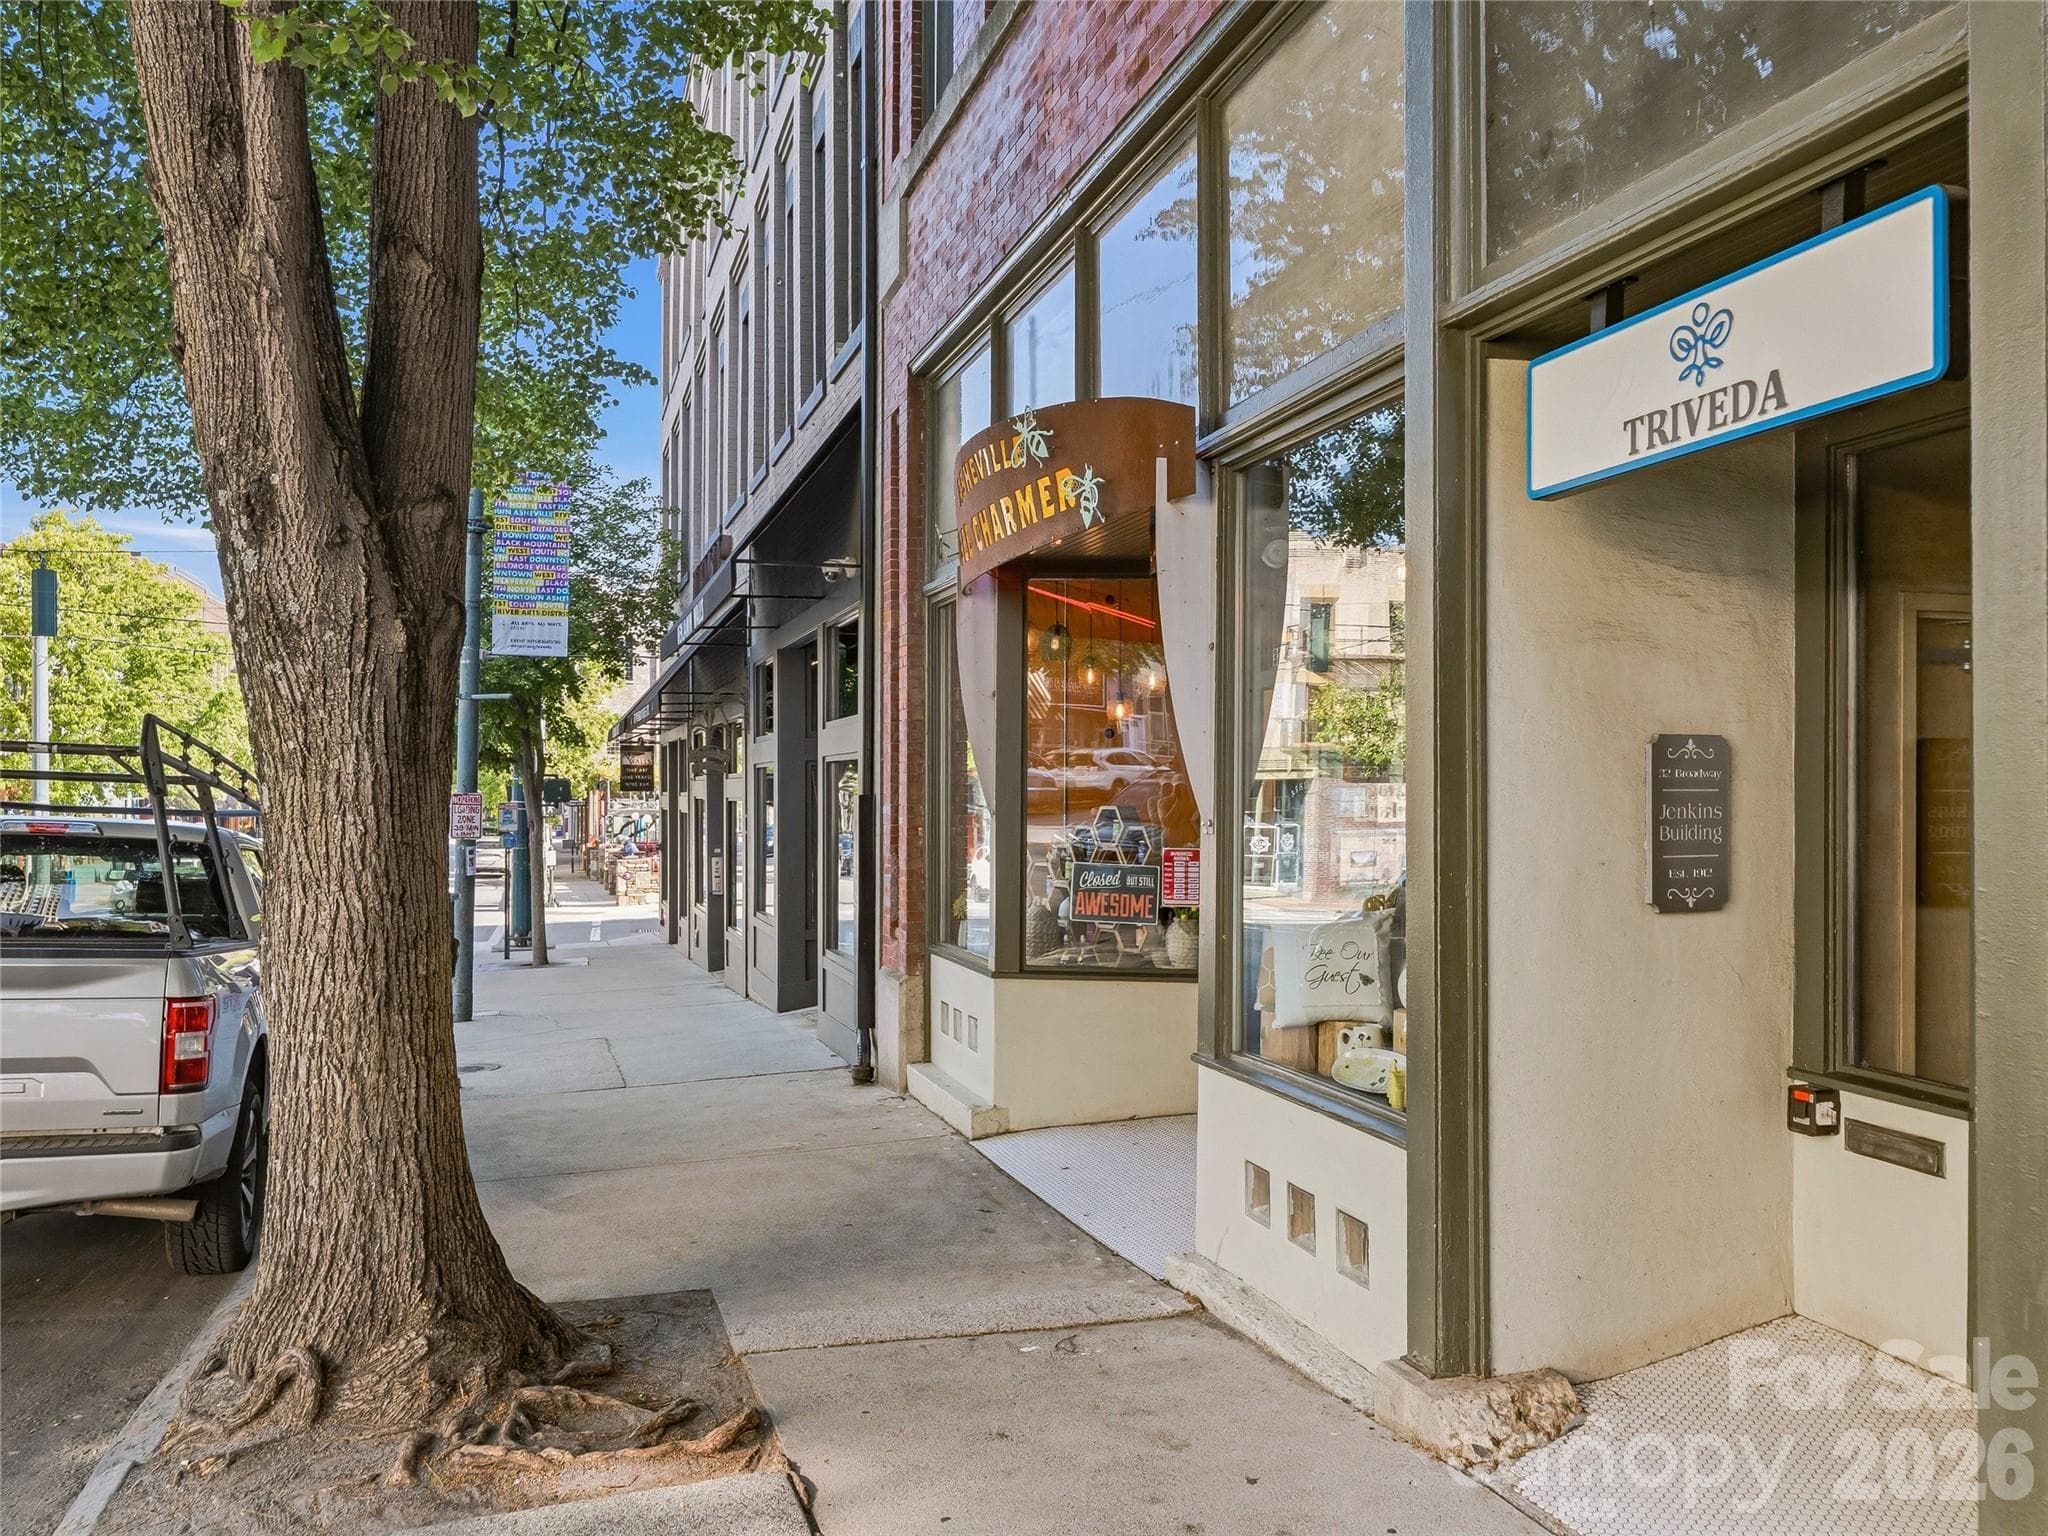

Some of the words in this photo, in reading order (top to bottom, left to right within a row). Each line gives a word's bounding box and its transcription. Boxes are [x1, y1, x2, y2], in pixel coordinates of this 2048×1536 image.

[1623, 368, 1790, 457] TRIVEDA
[972, 467, 1077, 552] CHARMER
[1674, 768, 1722, 781] Broadway
[1658, 802, 1723, 821] Jenkins
[1658, 825, 1723, 845] Building
[1079, 870, 1123, 890] Closed
[1126, 875, 1138, 887] BUT
[1138, 875, 1155, 888] STILL
[1693, 868, 1713, 878] 1912
[1074, 891, 1154, 919] AWESOME
[1340, 940, 1374, 961] Our
[1304, 961, 1361, 995] Guest
